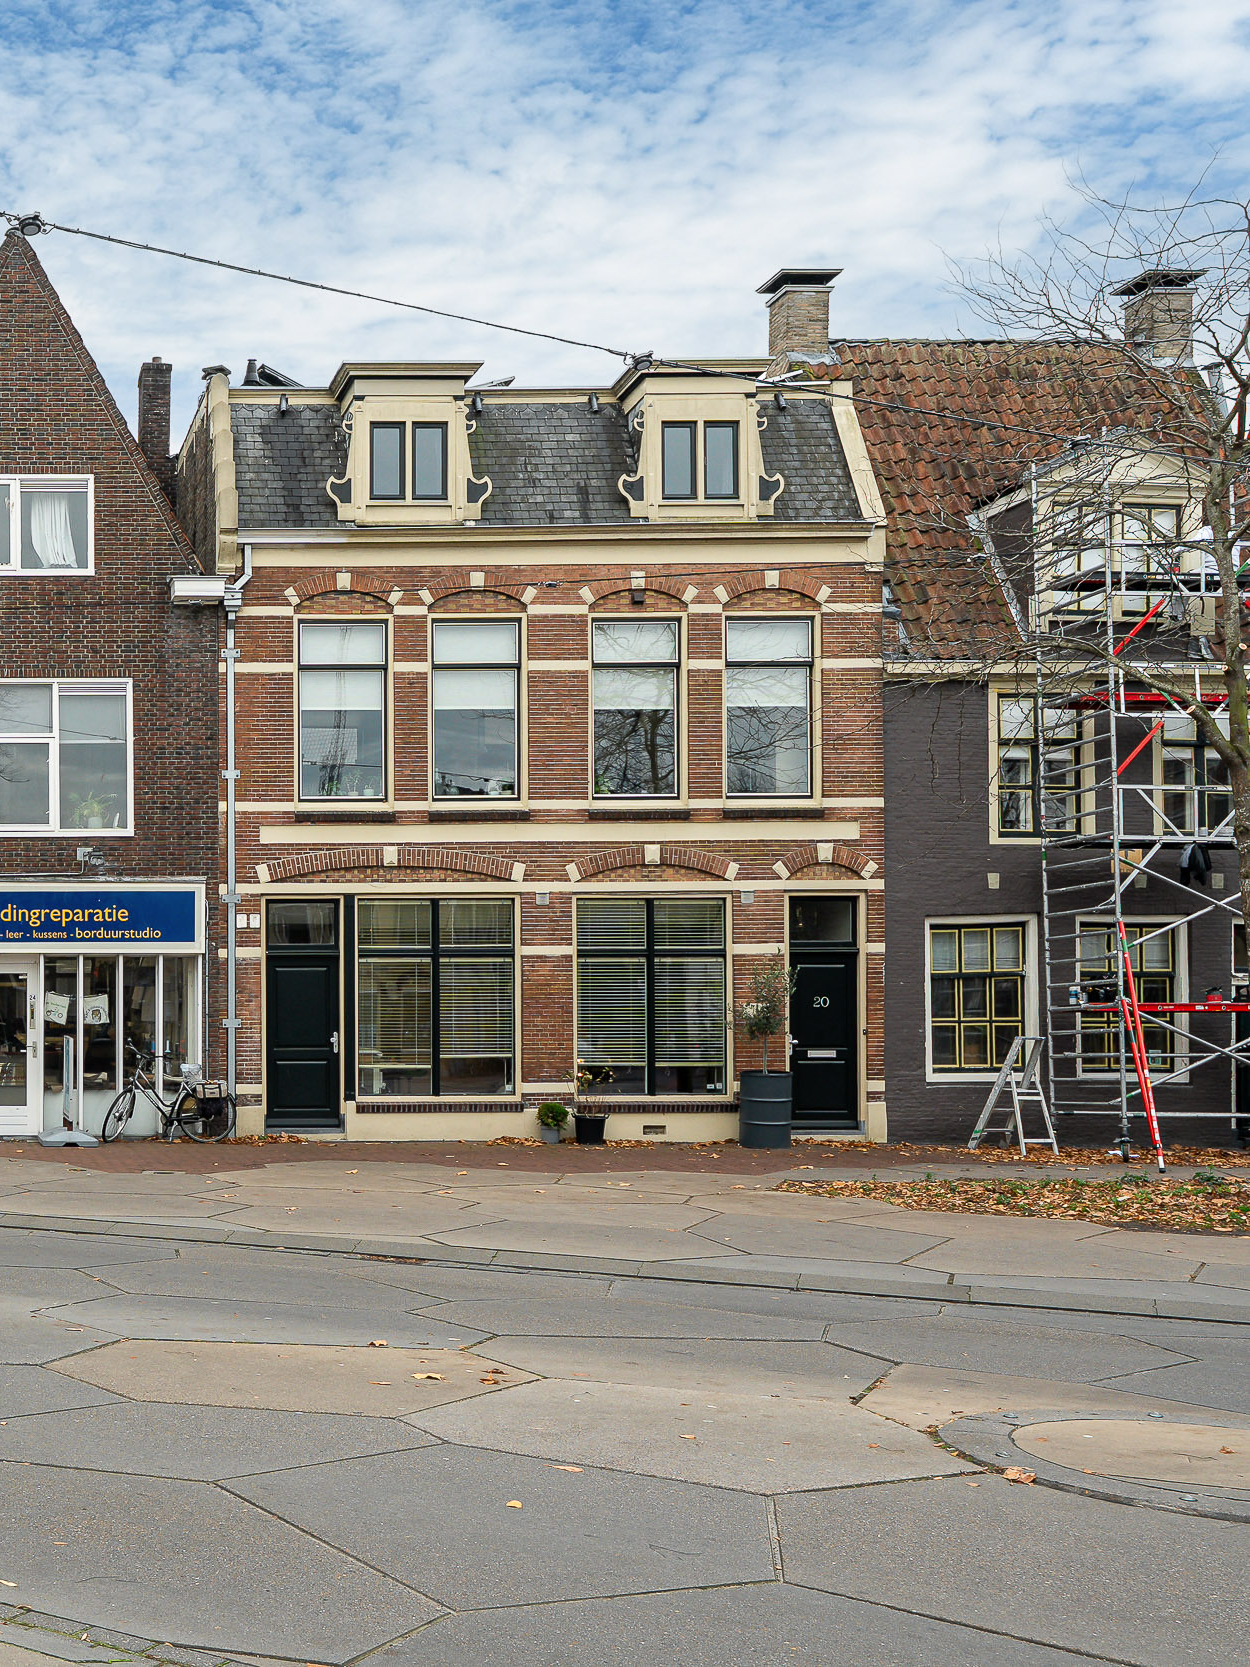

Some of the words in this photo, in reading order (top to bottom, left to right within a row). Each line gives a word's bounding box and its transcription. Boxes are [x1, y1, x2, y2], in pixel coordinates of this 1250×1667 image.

[6, 930, 24, 939] leer
[32, 930, 67, 939] kussens
[75, 927, 162, 939] borduurstudio
[813, 996, 830, 1008] 20
